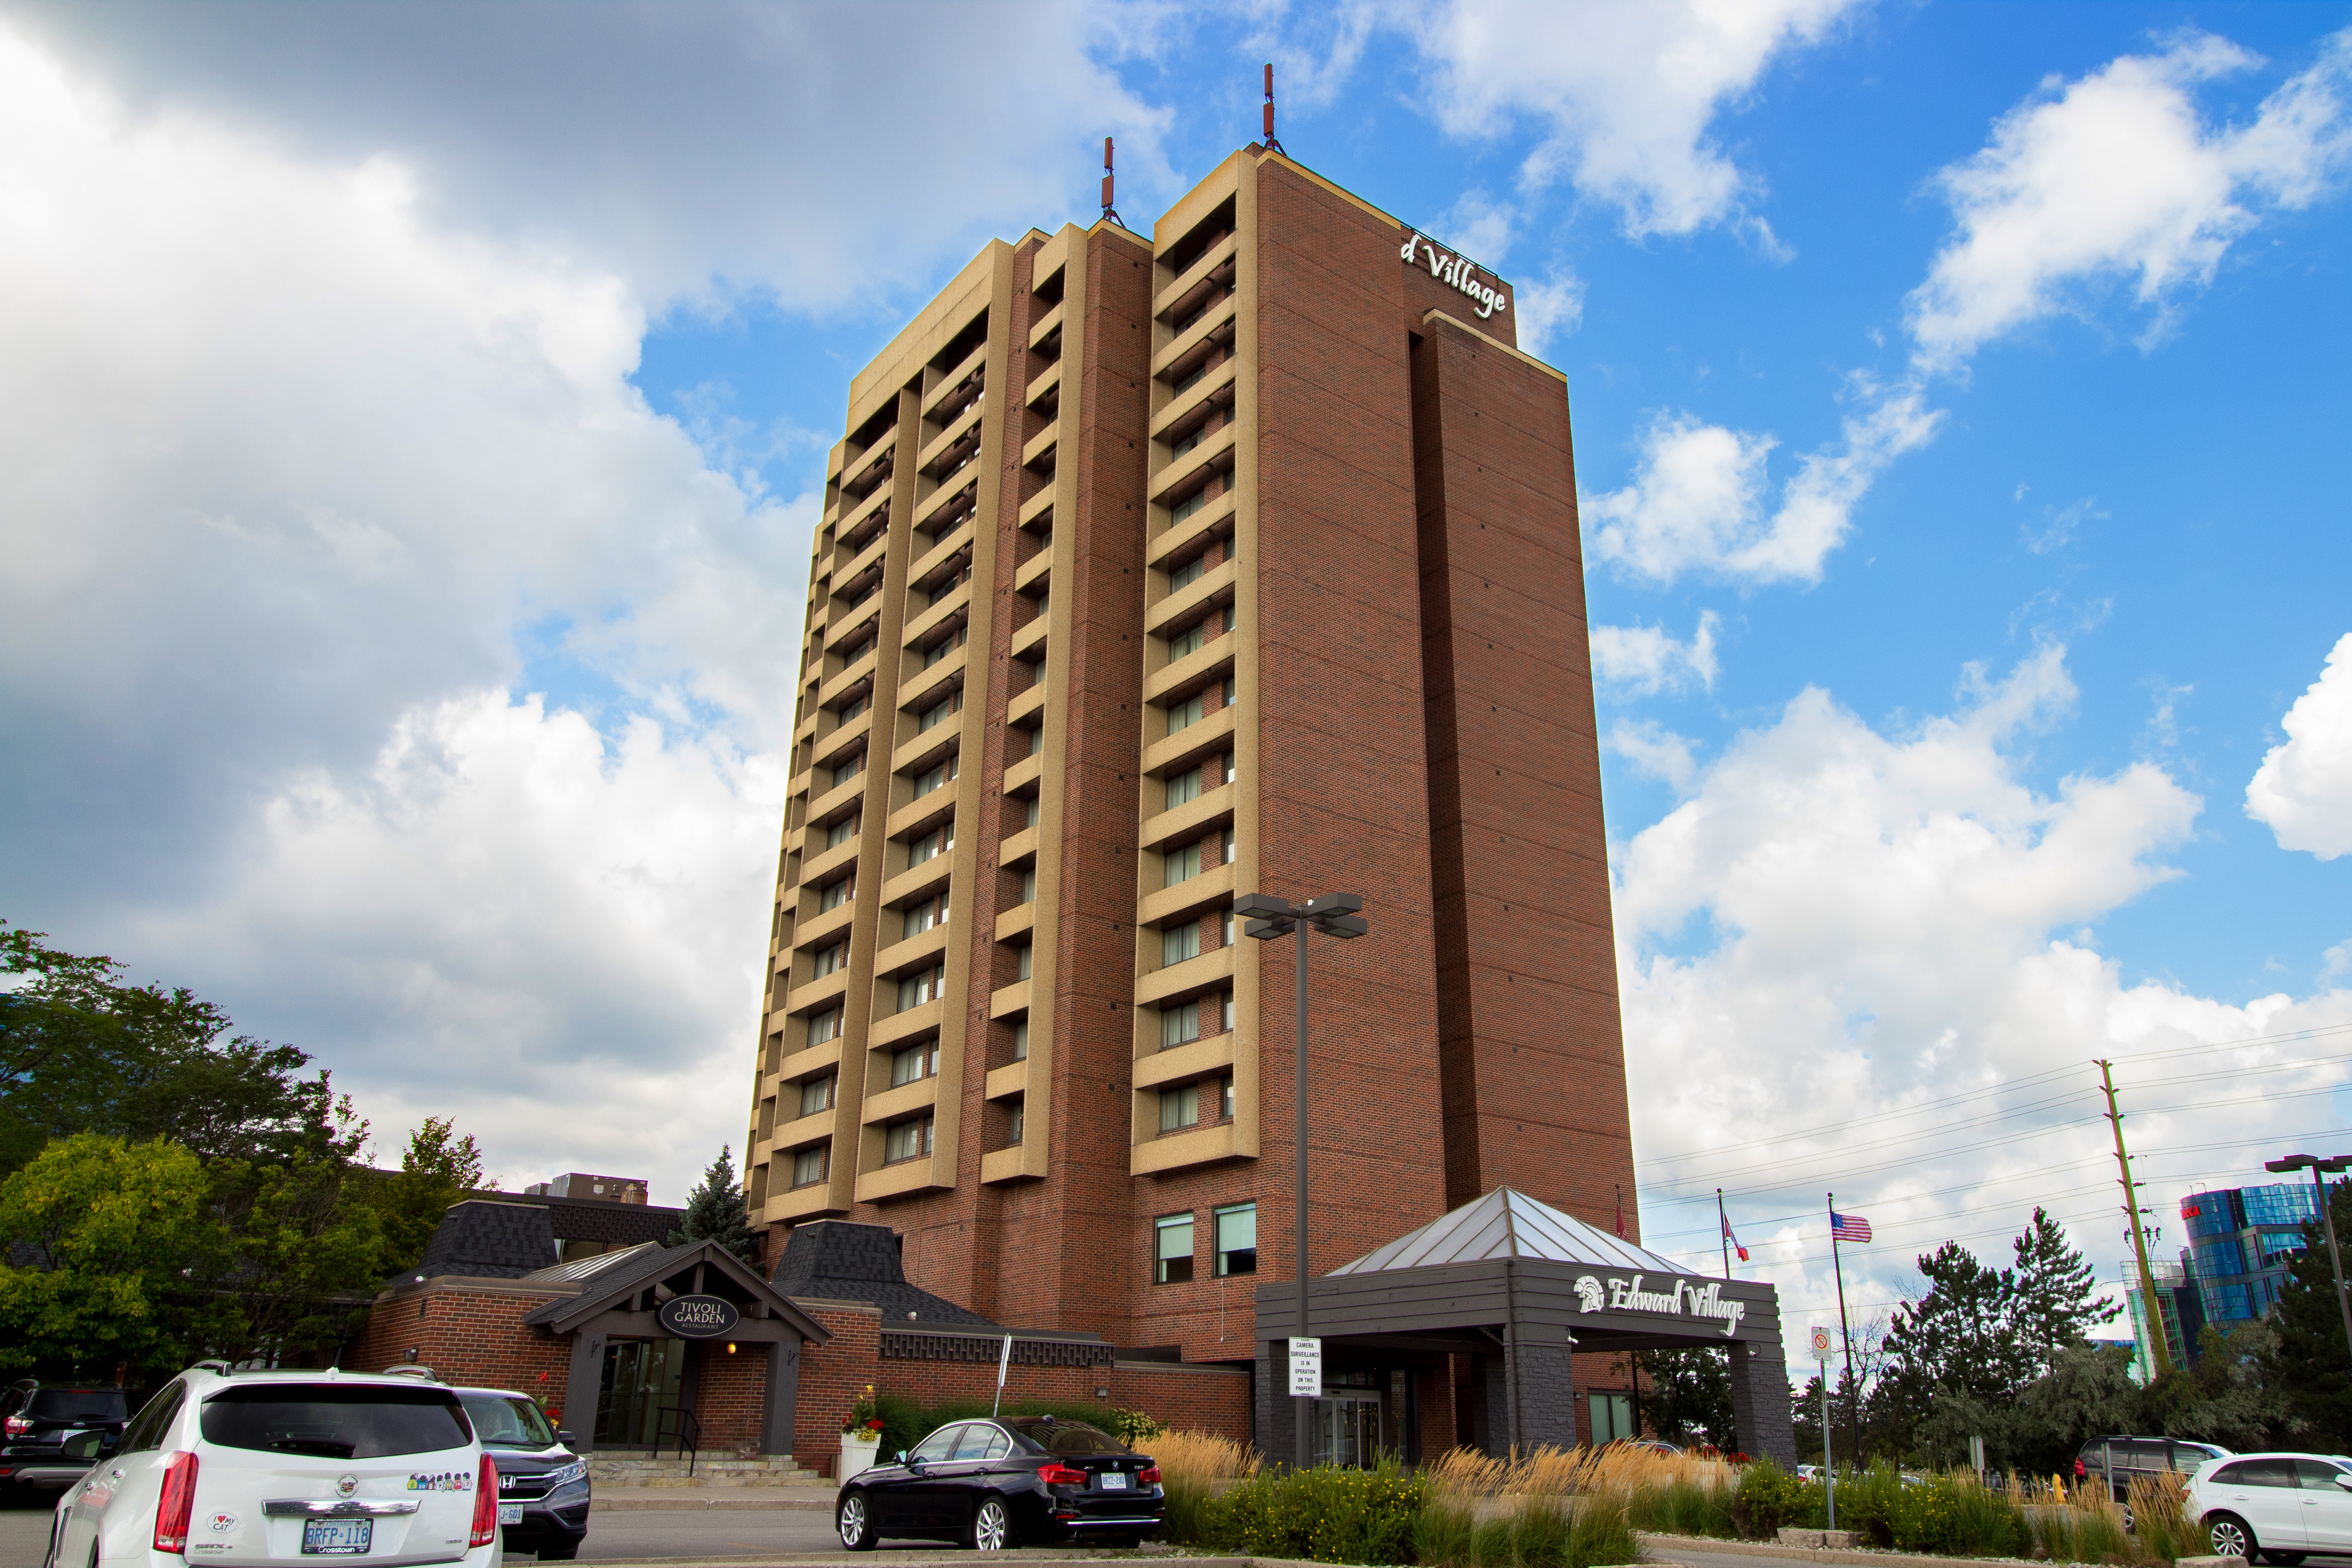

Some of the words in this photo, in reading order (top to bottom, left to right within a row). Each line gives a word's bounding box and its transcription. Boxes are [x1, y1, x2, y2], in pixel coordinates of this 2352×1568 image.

[1421, 245, 1505, 318] Village
[681, 1302, 720, 1314] TIVOLI
[1607, 1274, 1686, 1315] Edward
[1683, 1282, 1745, 1337] Village
[675, 1312, 725, 1324] GARDEN
[509, 1509, 521, 1519] 601
[225, 1517, 236, 1525] MY
[213, 1523, 230, 1532] CAT
[306, 1527, 338, 1544] BRFP
[346, 1527, 369, 1544] 118
